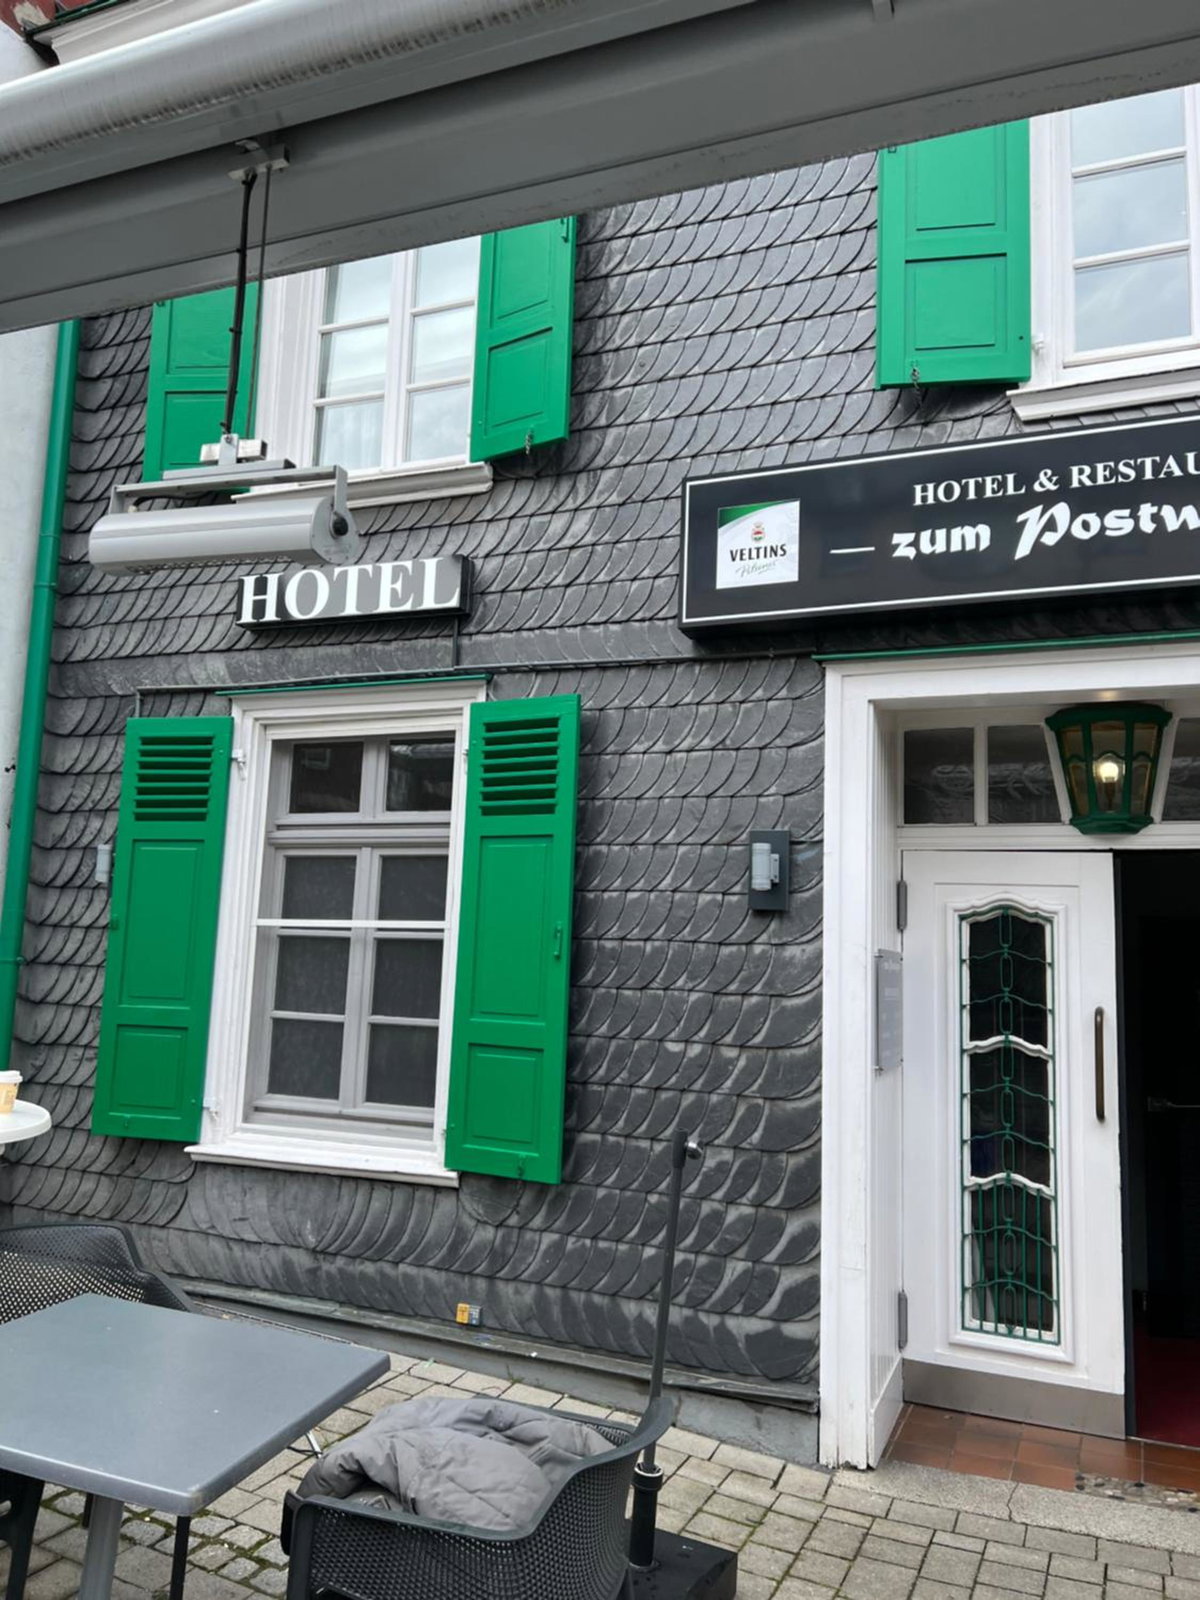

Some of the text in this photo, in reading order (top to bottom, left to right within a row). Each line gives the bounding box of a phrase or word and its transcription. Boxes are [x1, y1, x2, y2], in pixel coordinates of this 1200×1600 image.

[913, 472, 1026, 506] HOTEL
[1033, 468, 1060, 493] &
[729, 543, 787, 562] VELTINS
[891, 523, 991, 561] zum
[237, 557, 461, 623] HOTEL
